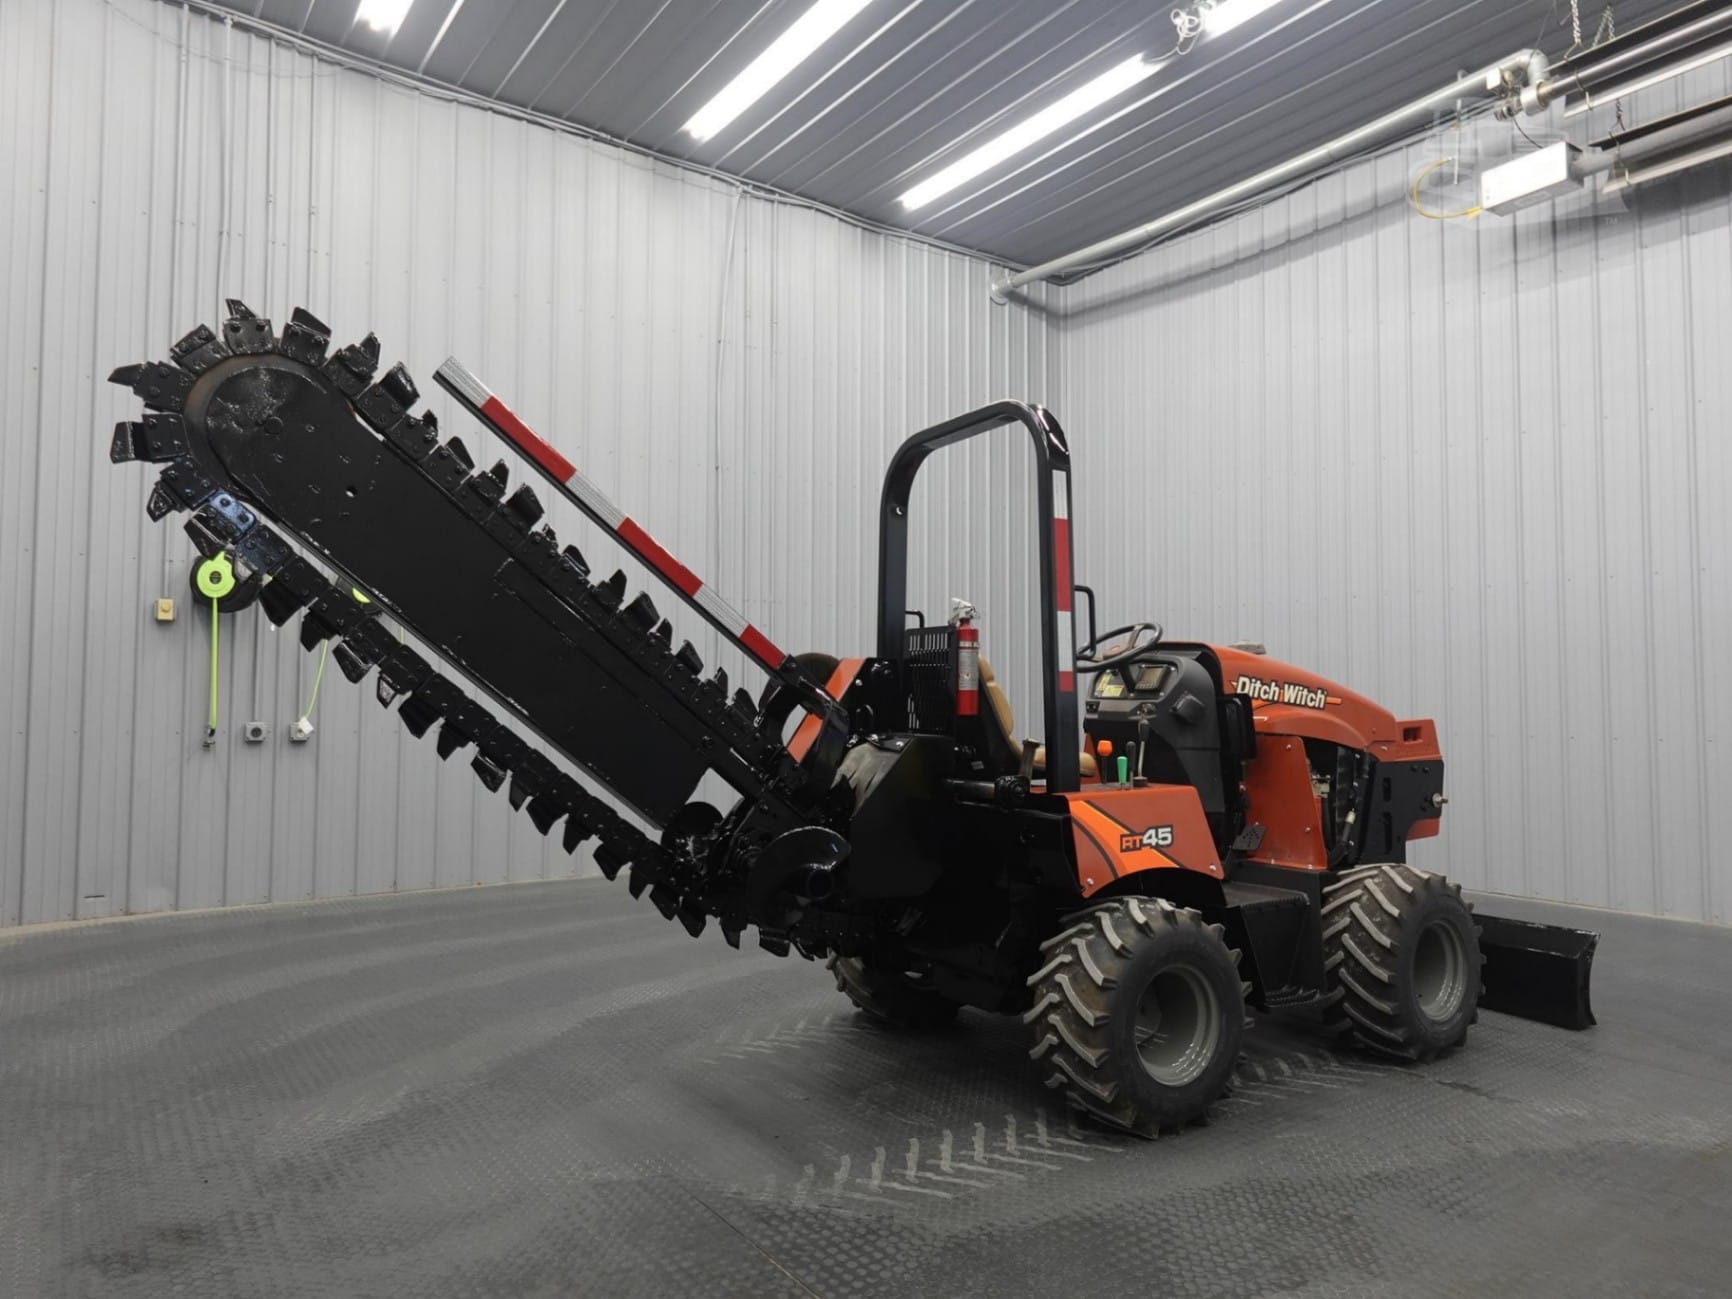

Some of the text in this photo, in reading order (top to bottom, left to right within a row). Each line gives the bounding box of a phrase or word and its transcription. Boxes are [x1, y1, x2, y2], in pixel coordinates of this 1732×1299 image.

[1236, 675, 1325, 709] Ditch Witch
[1122, 827, 1172, 850] RT45
